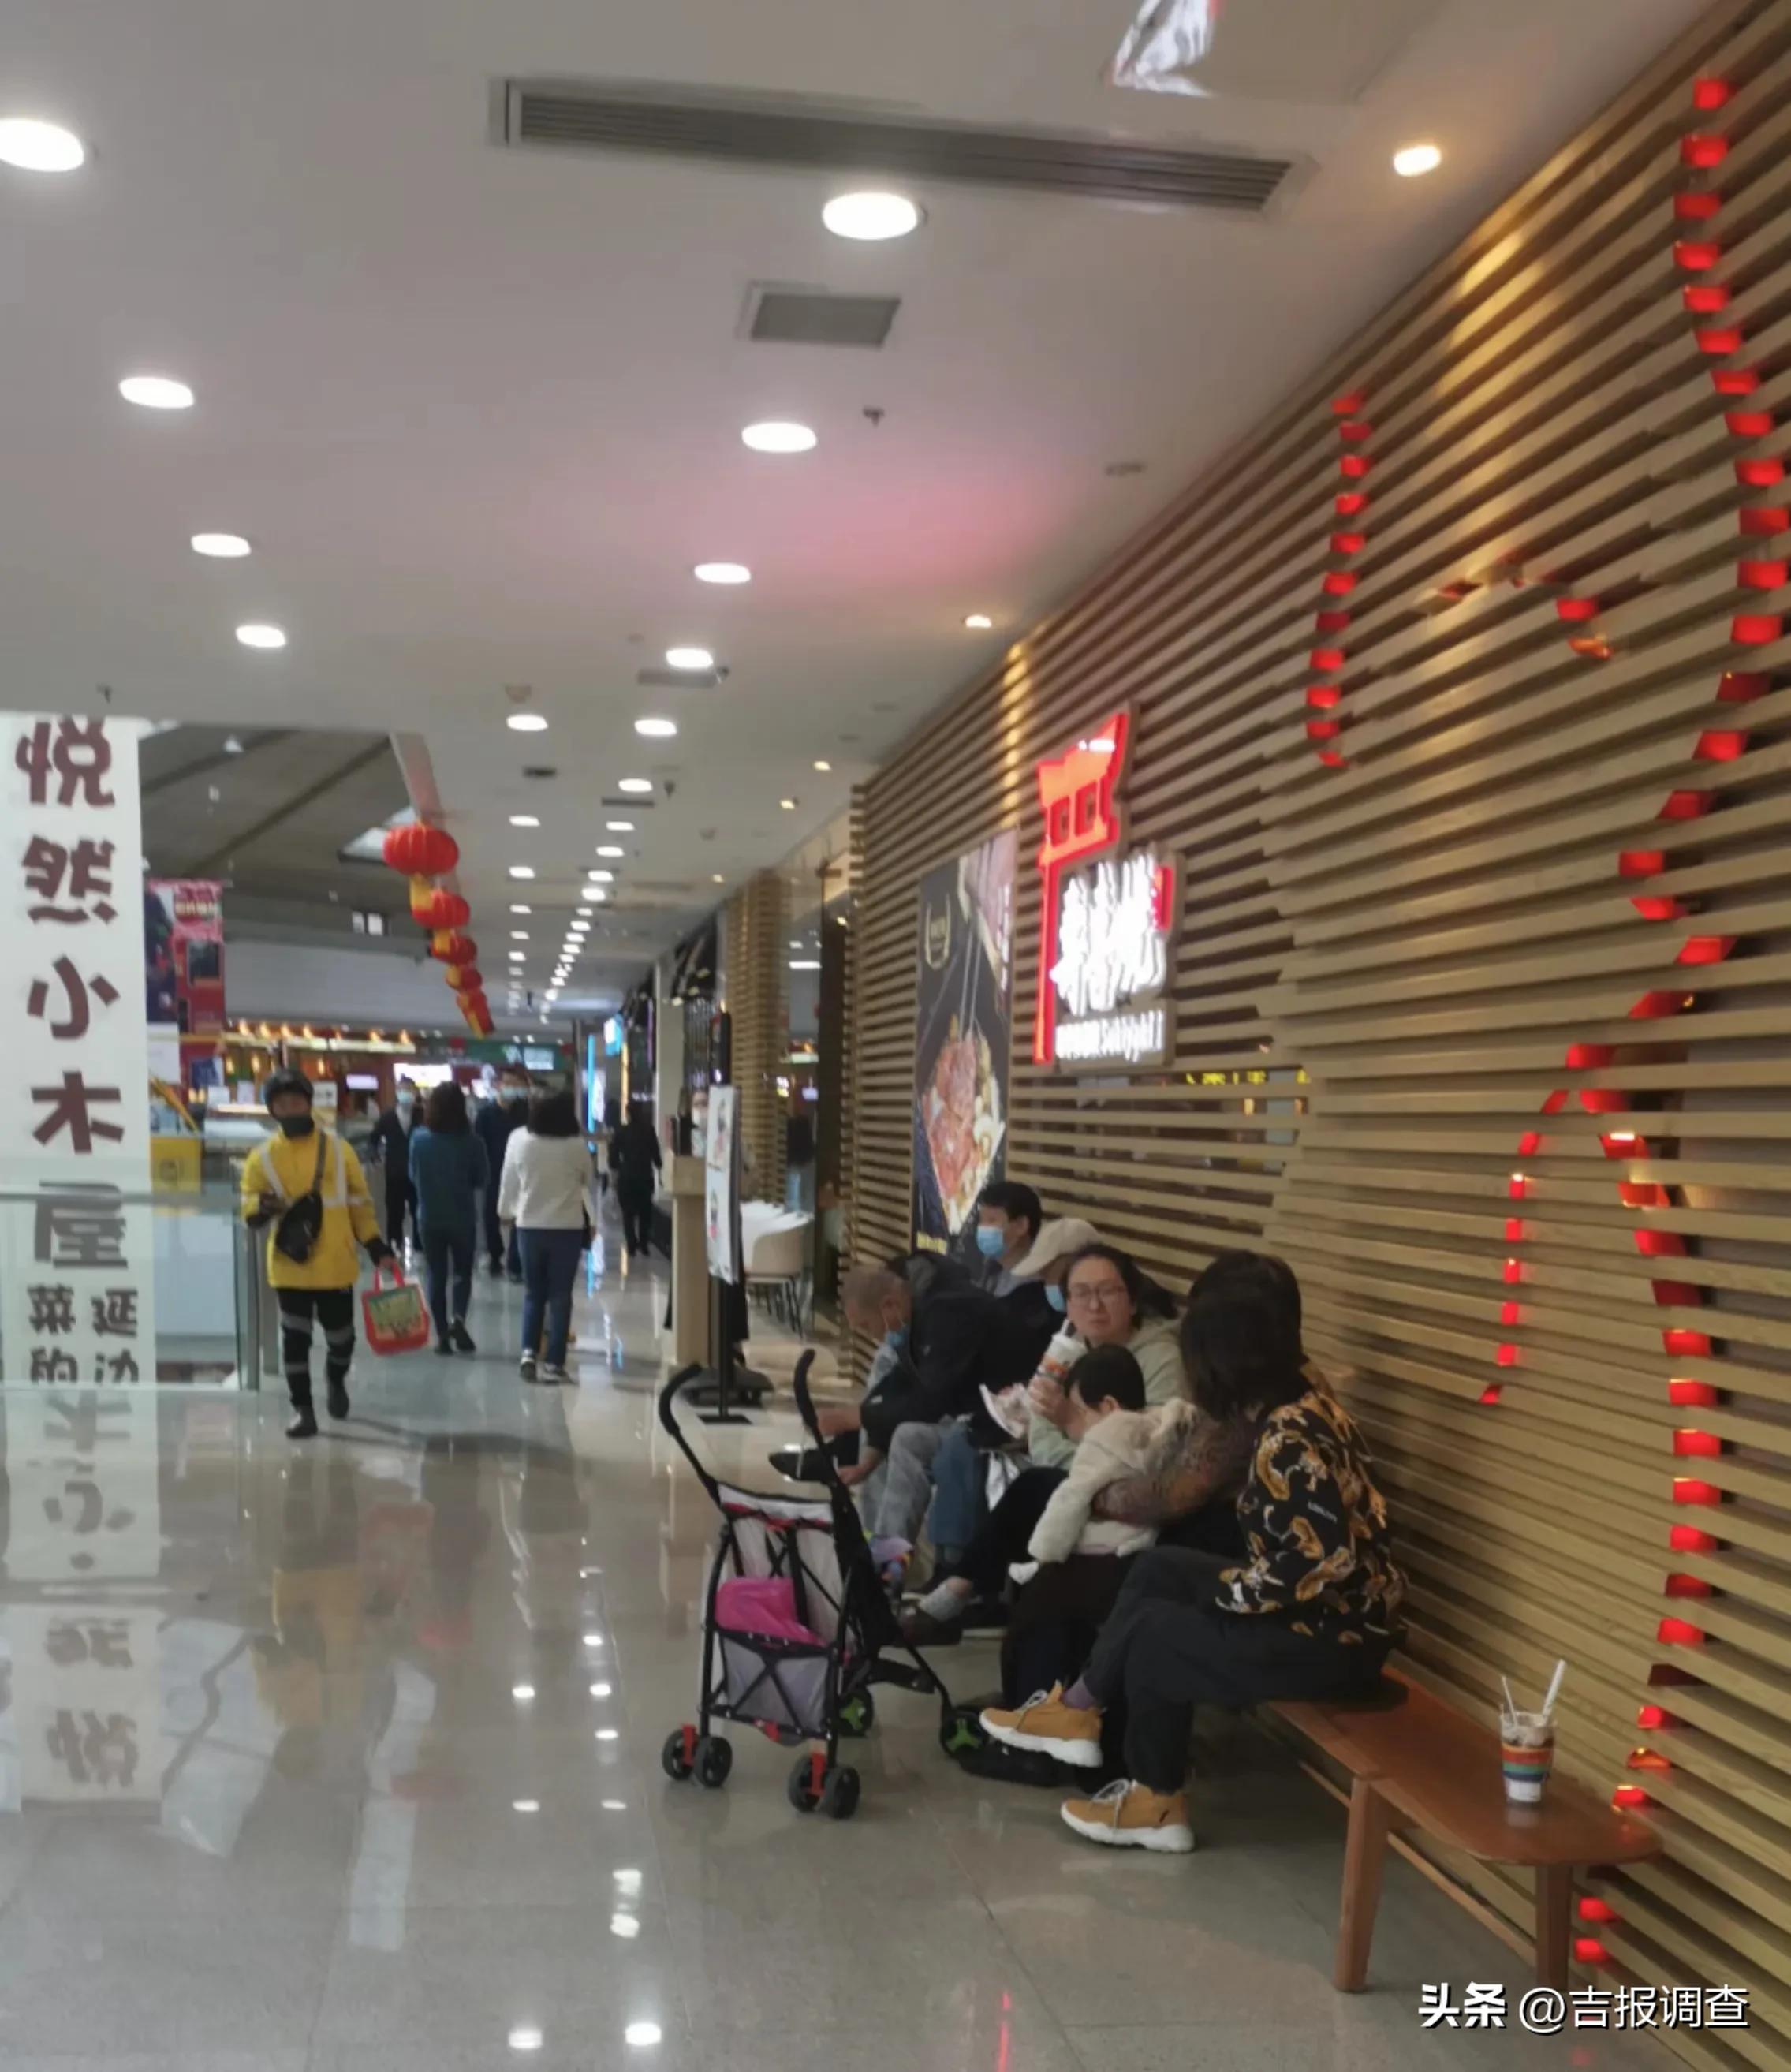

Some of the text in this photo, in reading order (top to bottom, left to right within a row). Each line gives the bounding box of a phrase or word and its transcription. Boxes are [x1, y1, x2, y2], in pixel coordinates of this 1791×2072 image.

[15, 714, 128, 1268] 悦然小木屋
